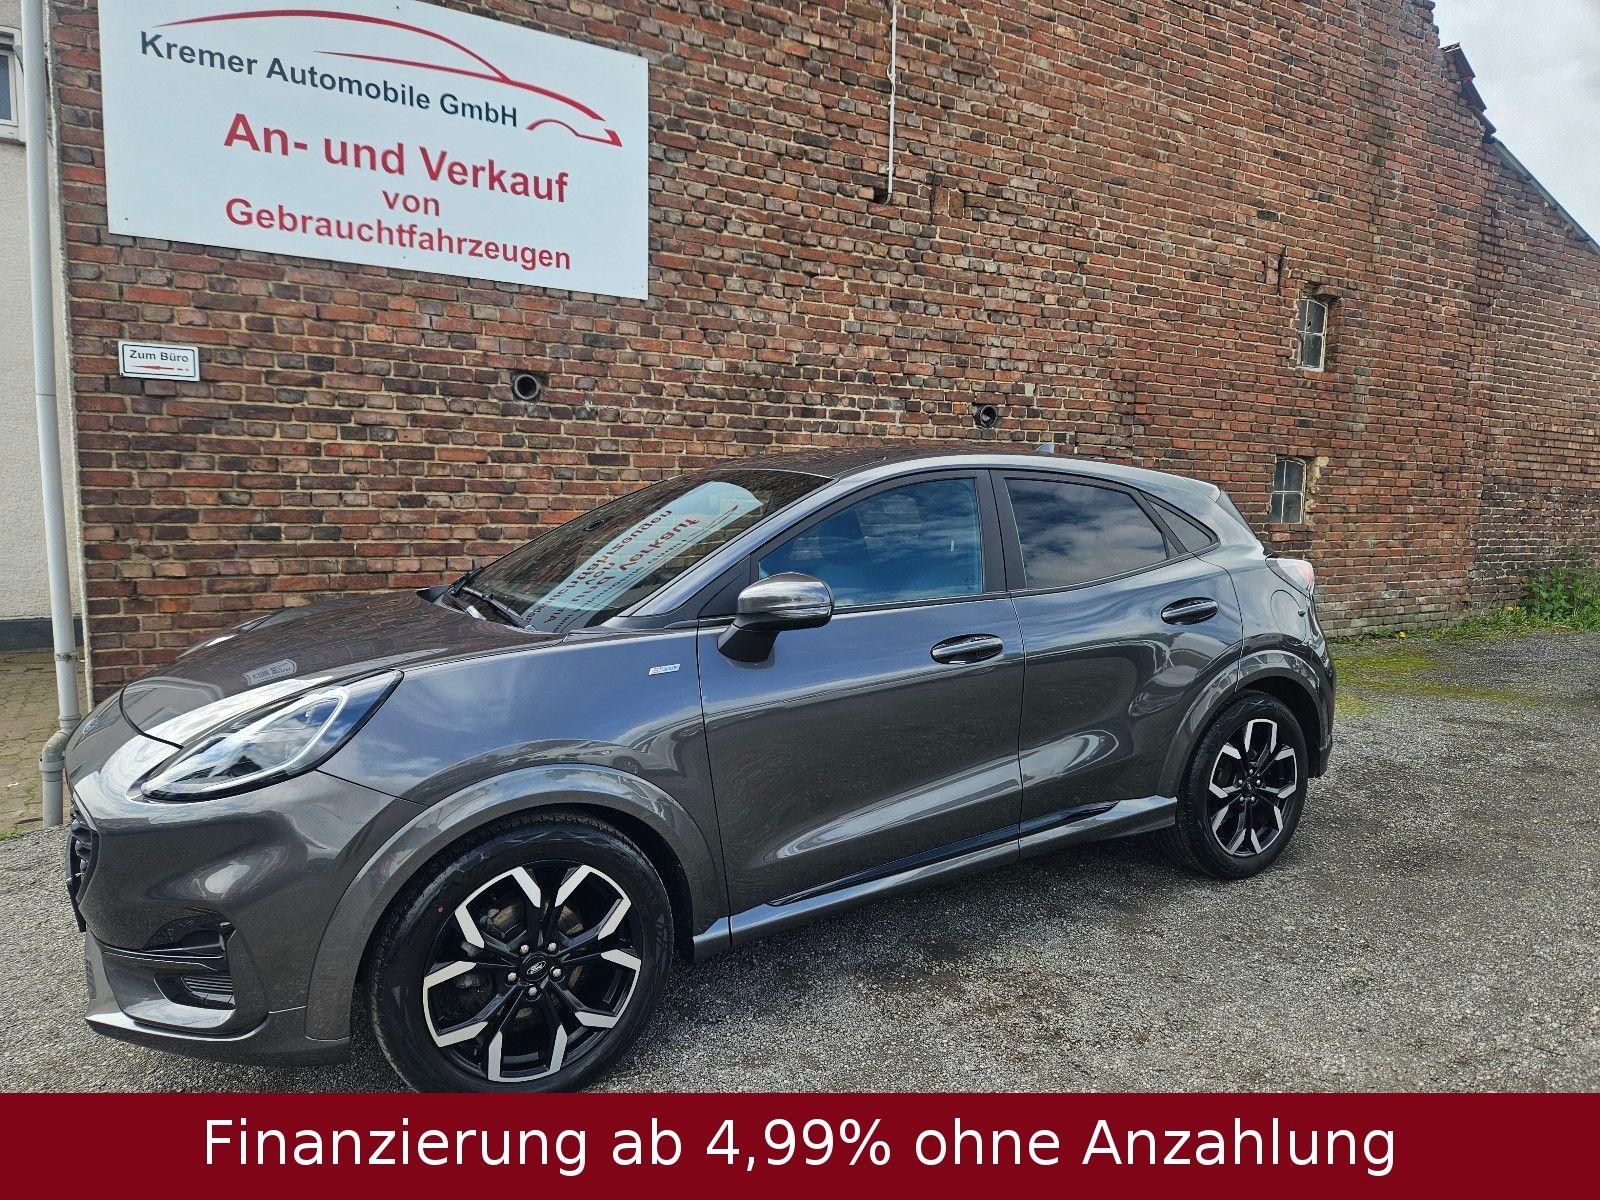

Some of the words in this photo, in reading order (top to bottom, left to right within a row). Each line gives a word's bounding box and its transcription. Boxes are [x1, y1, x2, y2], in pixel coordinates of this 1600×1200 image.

[140, 31, 258, 76] Kremer
[266, 57, 431, 110] Automobile
[440, 94, 517, 128] GmbH
[224, 113, 308, 156] An-
[324, 139, 405, 175] und
[419, 147, 569, 202] Verkauf
[226, 198, 571, 271] Gebrauchtfahrzeugen
[382, 189, 440, 217] von
[129, 349, 156, 360] Zum
[160, 352, 189, 363] Büro
